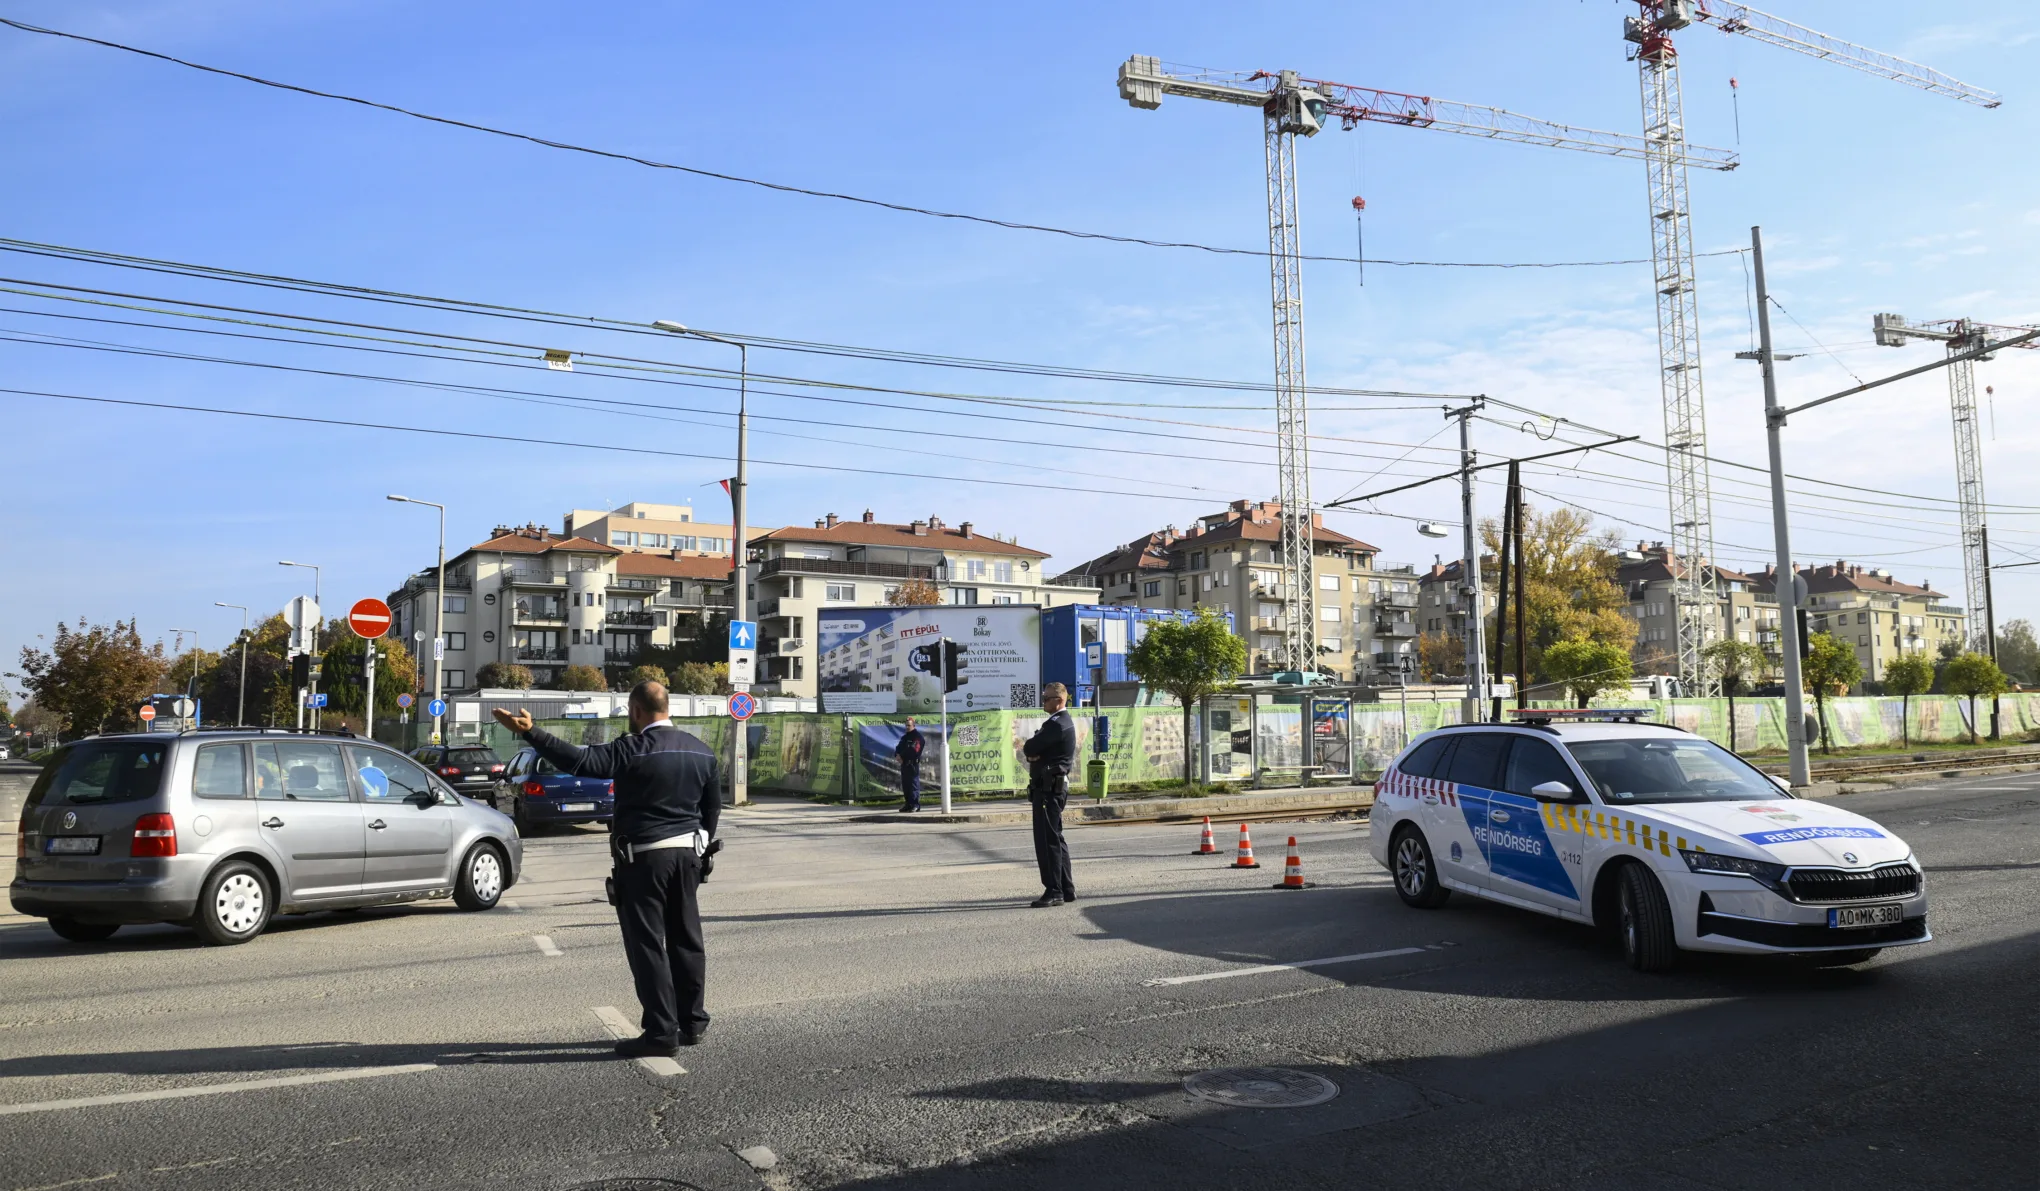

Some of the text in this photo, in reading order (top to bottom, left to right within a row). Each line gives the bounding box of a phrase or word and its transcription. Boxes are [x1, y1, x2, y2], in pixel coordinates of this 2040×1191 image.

[901, 629, 913, 638] ITT
[973, 627, 991, 637] Bókay
[949, 750, 1002, 760] AZ OTTHON
[952, 761, 1000, 773] AHOVÁ JÓ
[950, 774, 1005, 786] MEGÉRKEZNI
[1474, 825, 1541, 856] RENDŐRSÉG
[1763, 827, 1872, 843] RENDŐRSÉG
[1568, 852, 1582, 865] 112
